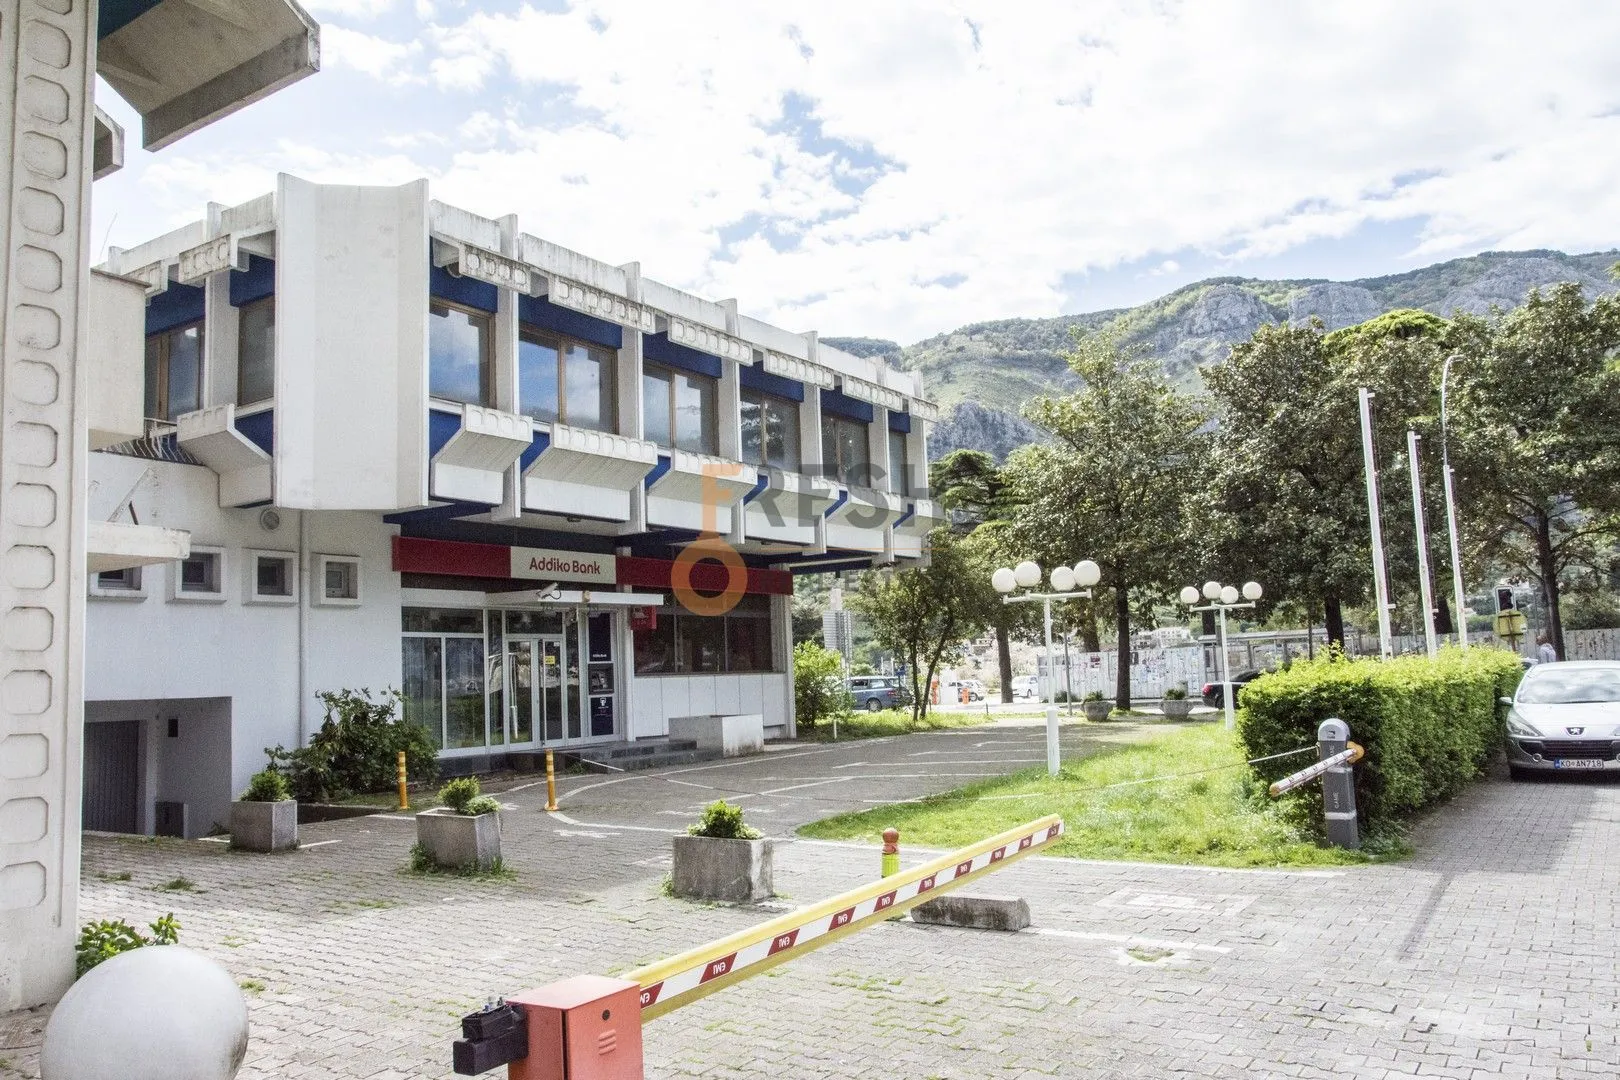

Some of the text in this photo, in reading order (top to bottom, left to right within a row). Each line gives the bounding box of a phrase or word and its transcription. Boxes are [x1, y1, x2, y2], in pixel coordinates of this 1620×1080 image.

[529, 557, 601, 575] Addiko Bank
[713, 961, 726, 975] EMI
[640, 992, 650, 1004] EM
